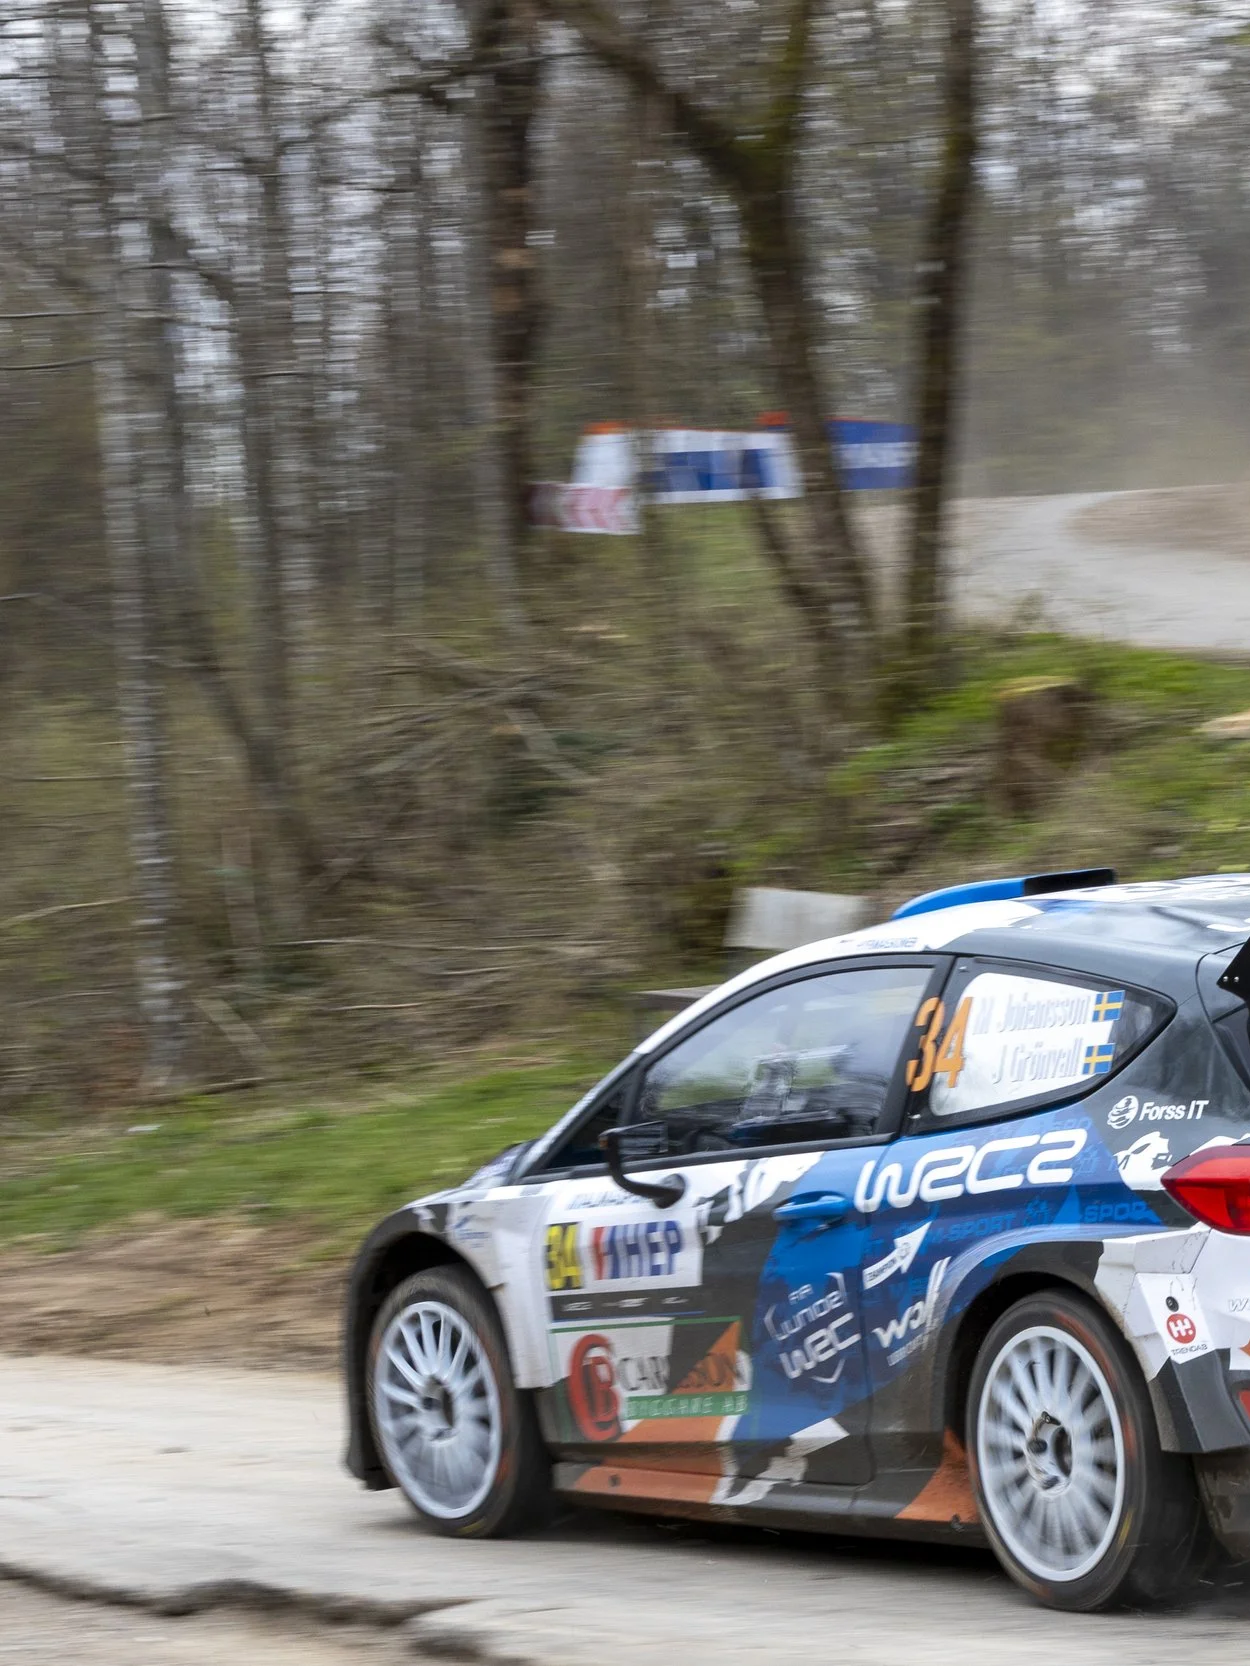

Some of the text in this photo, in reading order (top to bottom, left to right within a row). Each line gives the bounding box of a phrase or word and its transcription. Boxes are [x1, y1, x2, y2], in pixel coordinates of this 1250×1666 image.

[997, 990, 1091, 1033] Johansson
[906, 996, 974, 1092] 34
[1010, 1036, 1083, 1083] Grönvall
[1139, 1100, 1210, 1121] Forss IT
